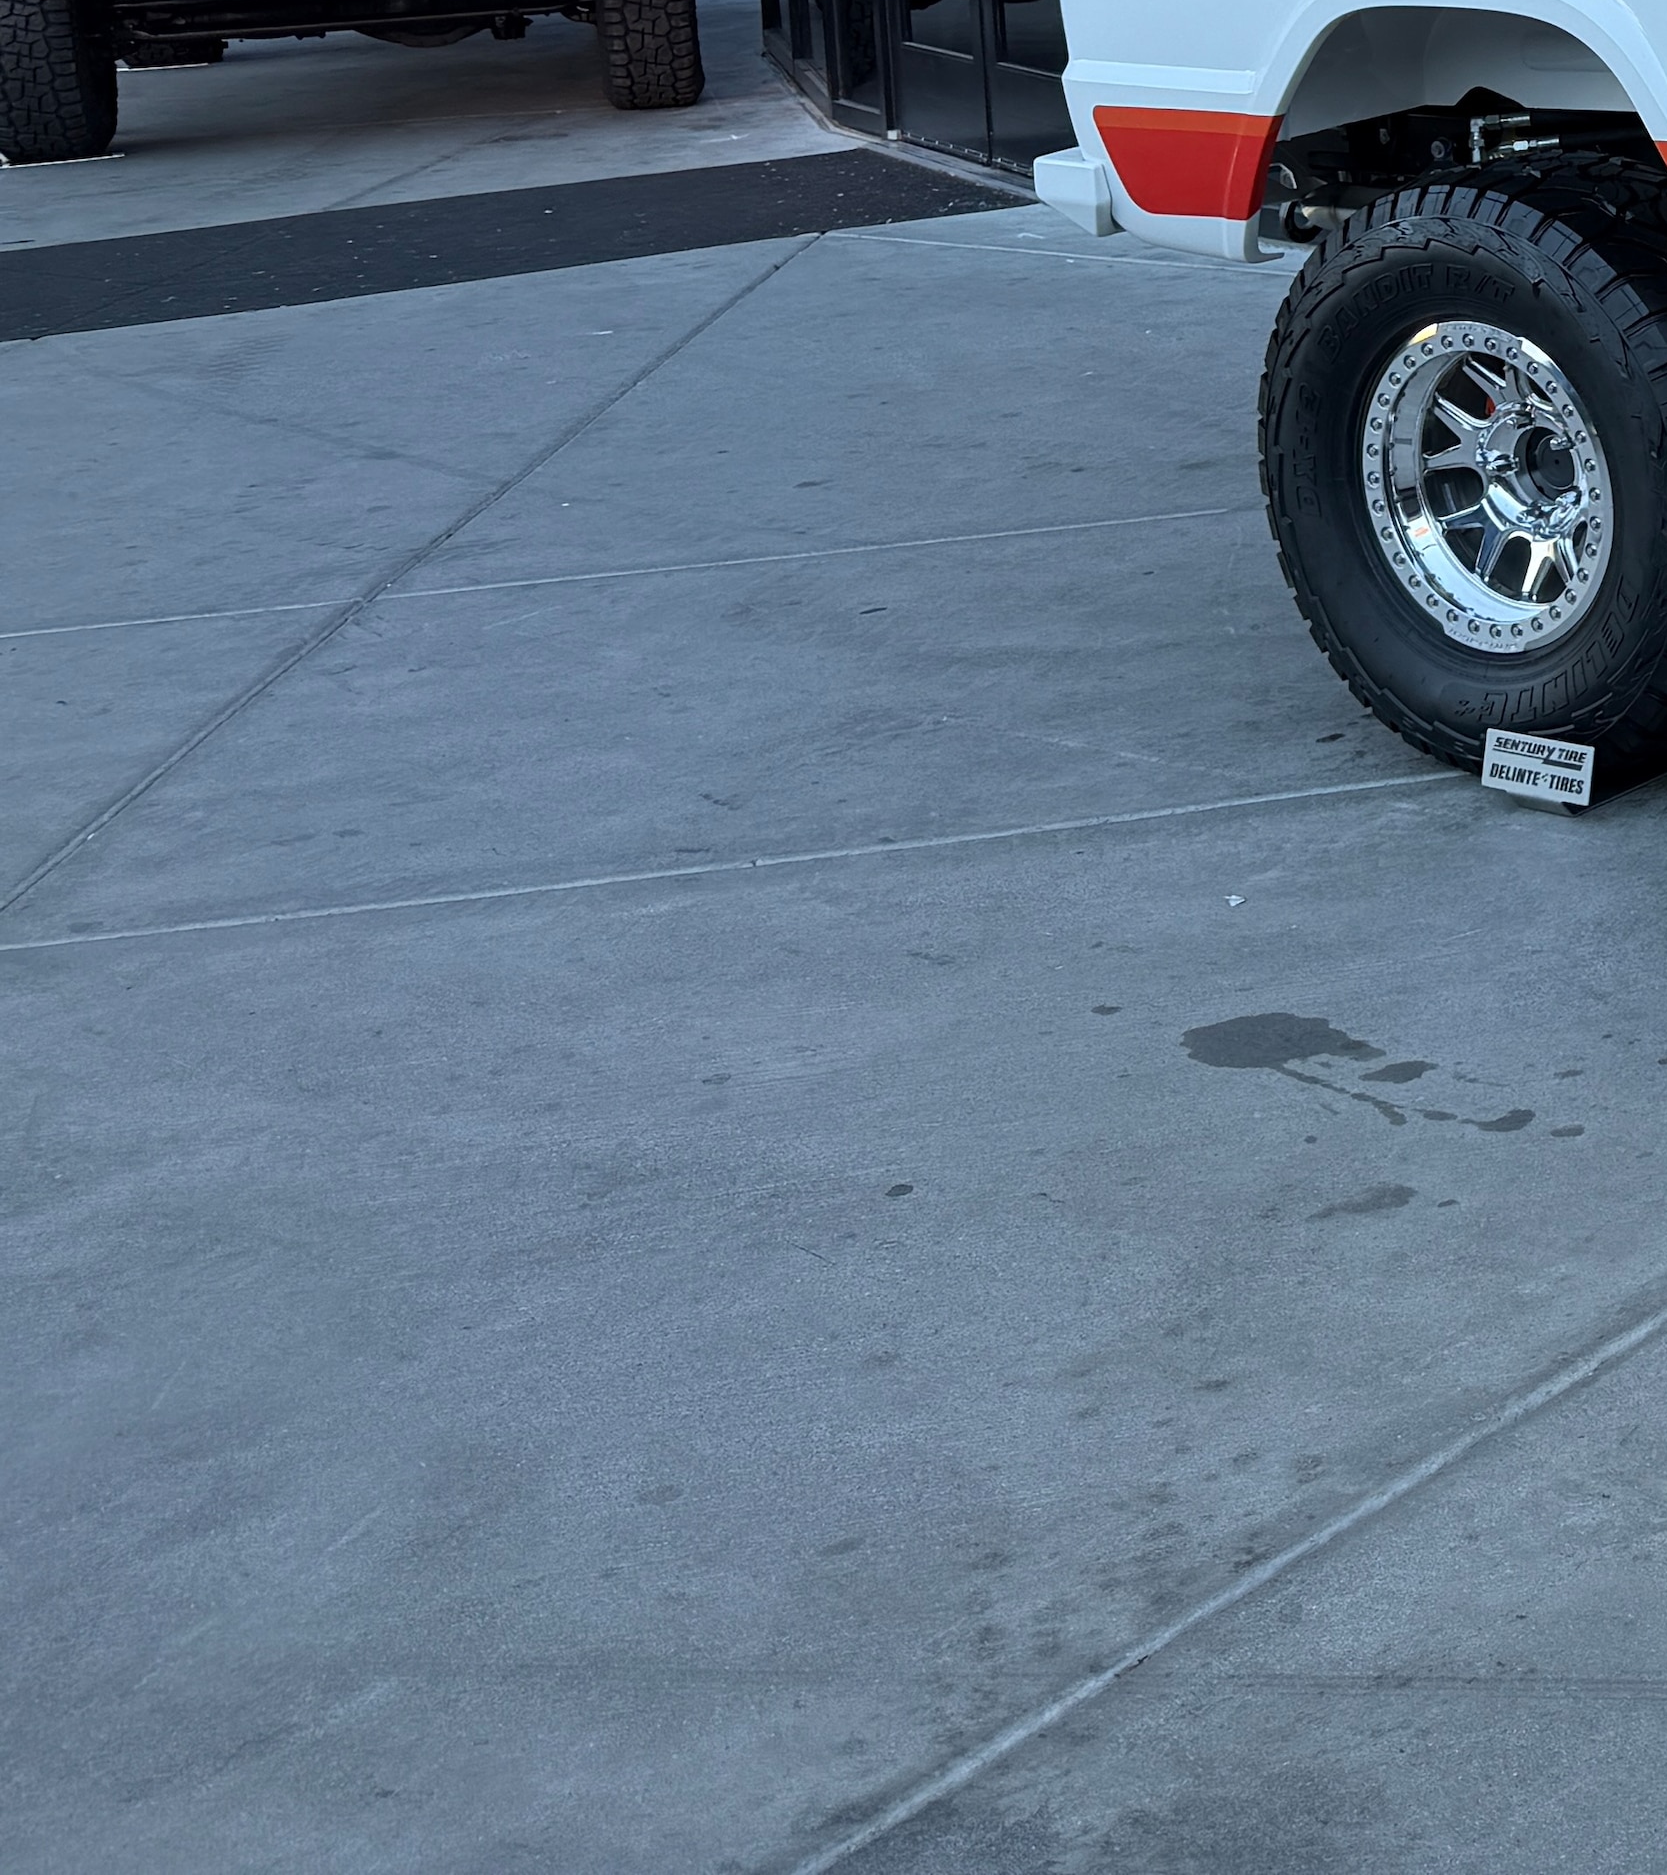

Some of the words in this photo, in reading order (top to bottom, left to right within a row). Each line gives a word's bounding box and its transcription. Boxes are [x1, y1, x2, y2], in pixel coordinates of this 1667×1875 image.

[1493, 736, 1557, 761] SENTURY
[1557, 747, 1588, 764] TIRE
[1489, 762, 1541, 787] DELINTE
[1548, 773, 1585, 795] TIRES
